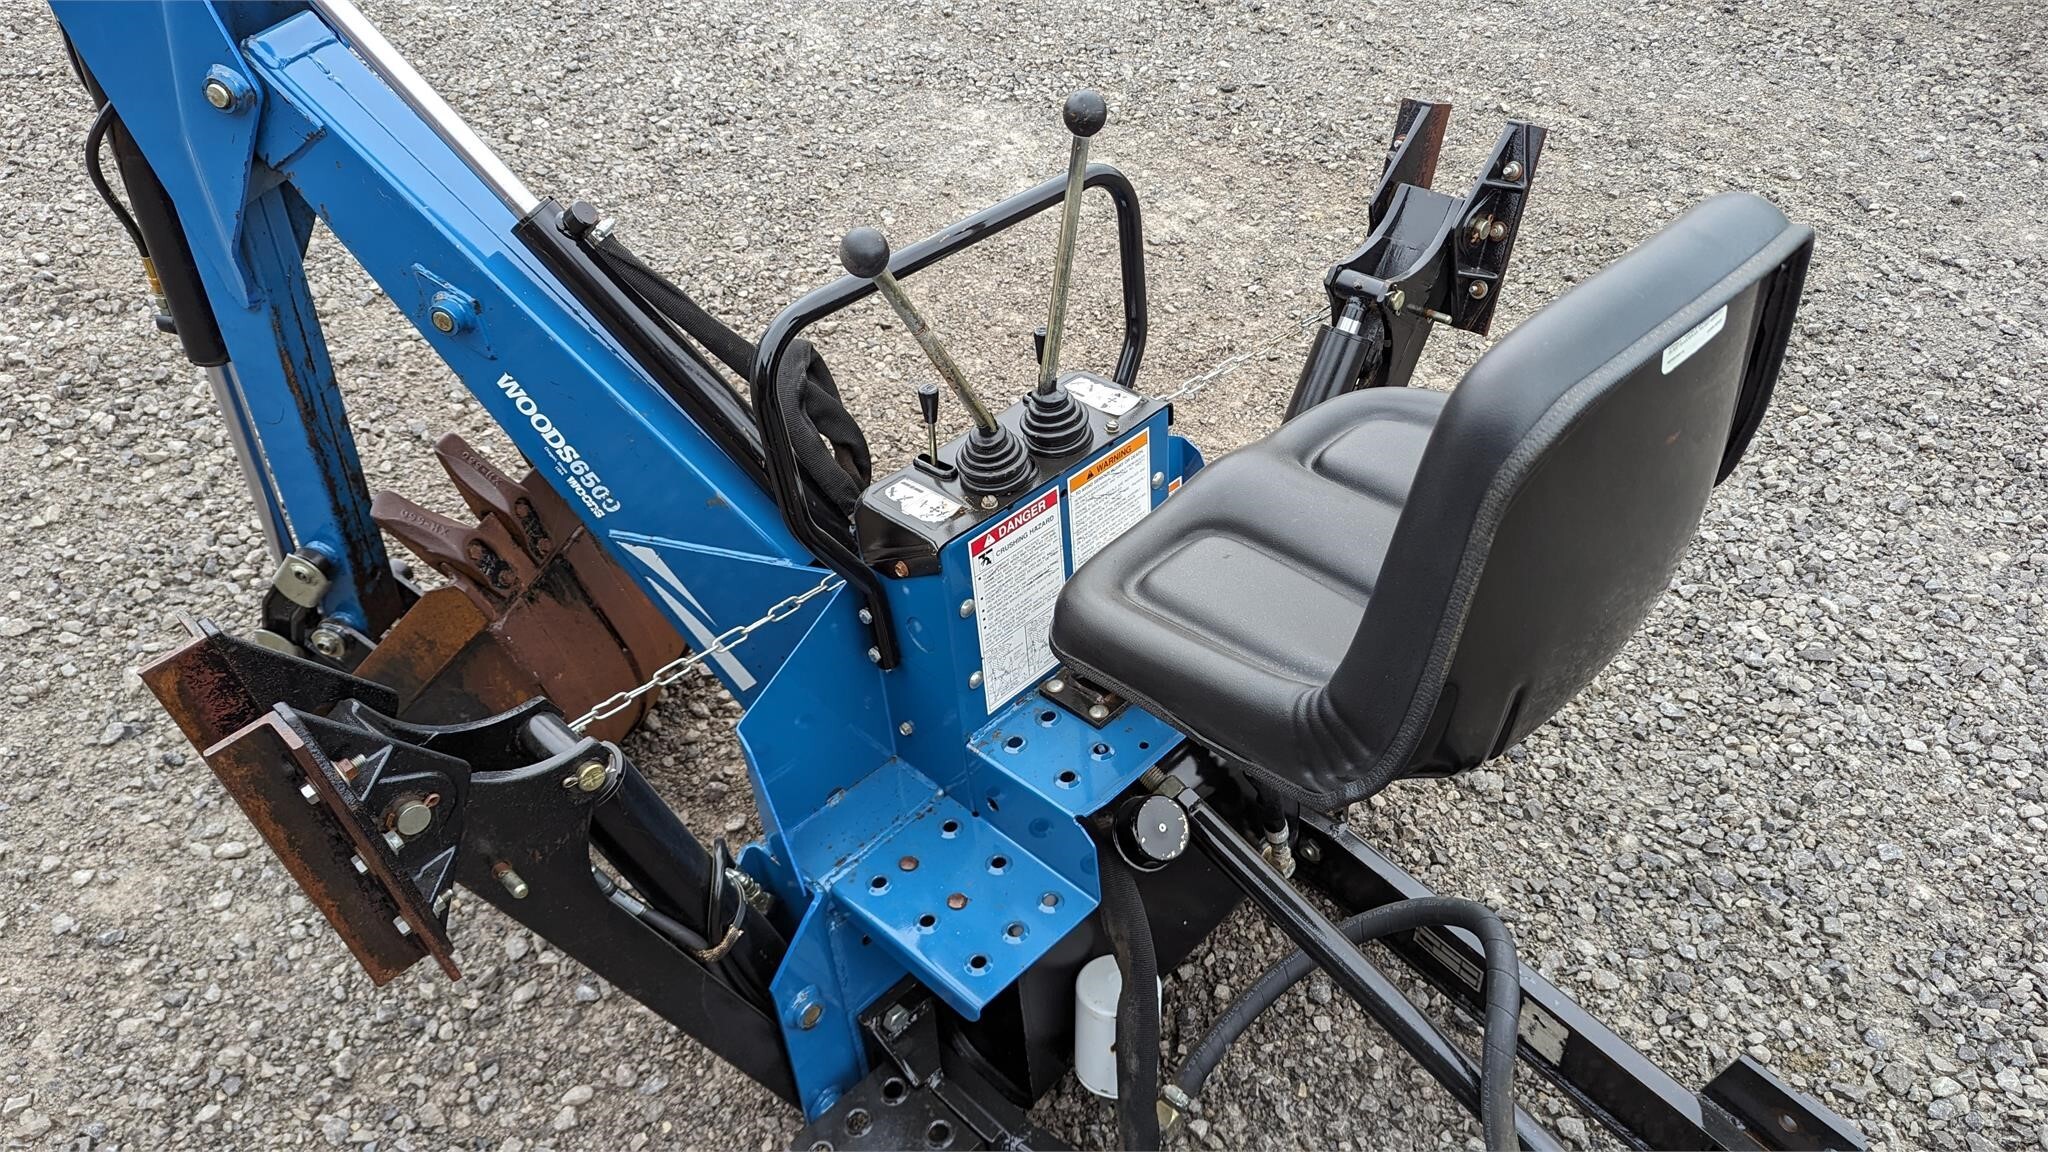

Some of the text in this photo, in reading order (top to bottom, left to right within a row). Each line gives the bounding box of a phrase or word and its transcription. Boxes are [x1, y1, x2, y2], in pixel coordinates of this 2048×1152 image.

[1096, 445, 1131, 473] WARNING
[996, 515, 1054, 557] CRUSHING HAZARD
[998, 499, 1046, 538] DANGER
